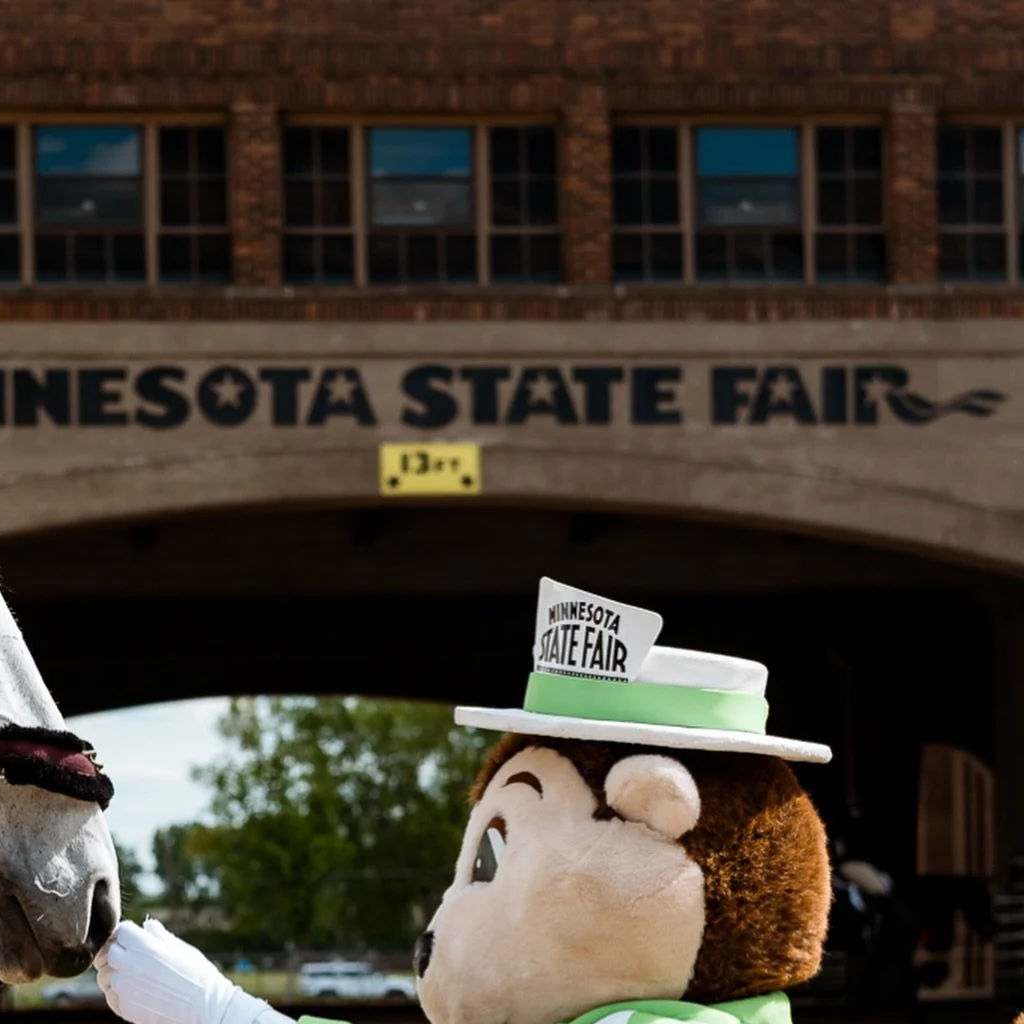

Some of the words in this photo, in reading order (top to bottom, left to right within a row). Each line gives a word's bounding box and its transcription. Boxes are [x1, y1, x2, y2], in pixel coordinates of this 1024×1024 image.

[399, 364, 682, 430] STATE
[710, 365, 1006, 427] FAIR
[548, 601, 620, 635] MINNESOTA
[538, 624, 580, 666] STATE
[581, 626, 628, 673] FAIR
